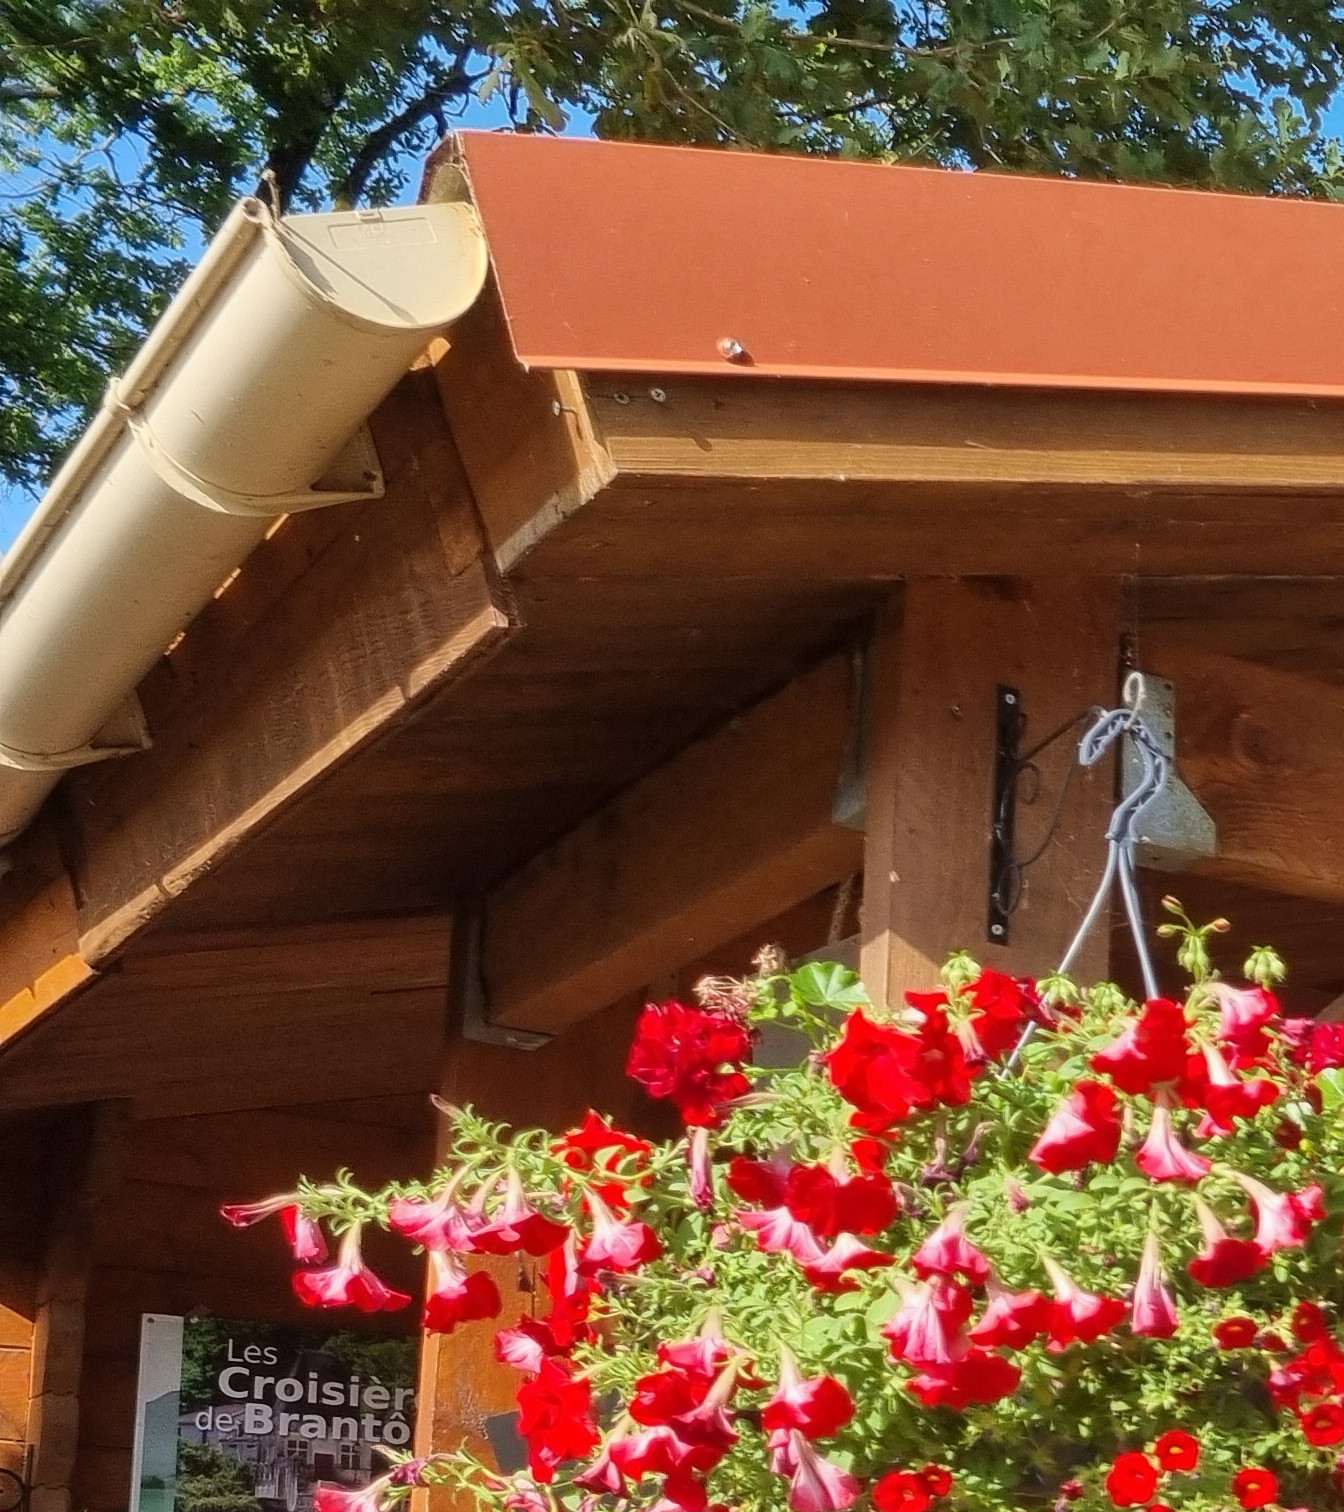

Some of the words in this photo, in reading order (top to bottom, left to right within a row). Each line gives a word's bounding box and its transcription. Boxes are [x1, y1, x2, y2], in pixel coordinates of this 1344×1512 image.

[226, 1338, 278, 1366] Les
[218, 1366, 415, 1411] Croisièr
[195, 1405, 234, 1433] de
[244, 1402, 411, 1445] Brantô
